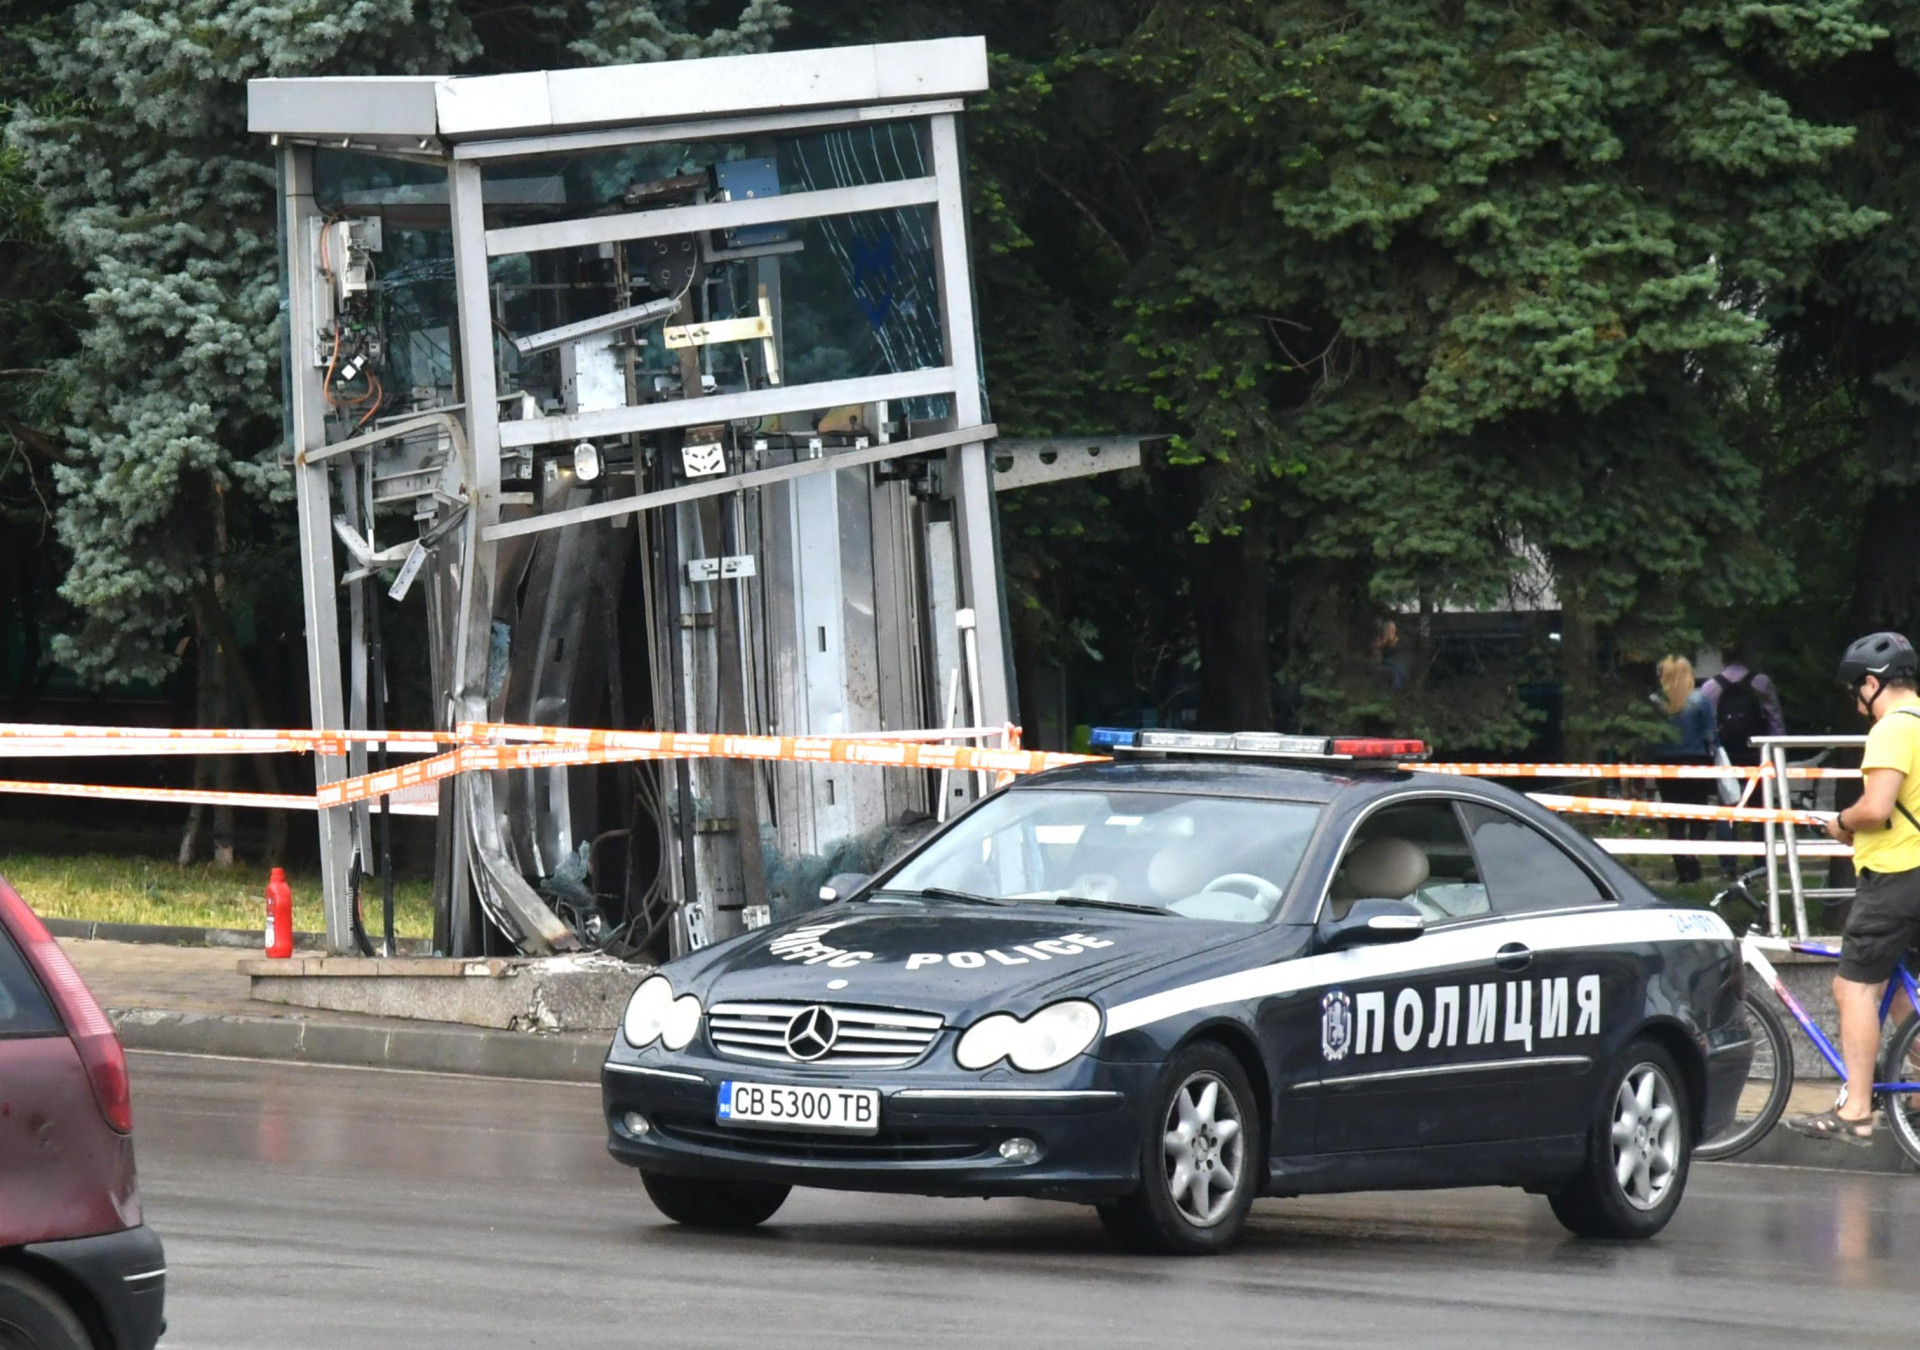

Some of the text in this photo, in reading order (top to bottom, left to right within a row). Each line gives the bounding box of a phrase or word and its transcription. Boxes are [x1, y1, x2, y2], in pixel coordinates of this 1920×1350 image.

[905, 933, 1114, 970] POLICE
[1355, 975, 1600, 1053] ПОЛИЦИЯ
[838, 1093, 872, 1122] TB
